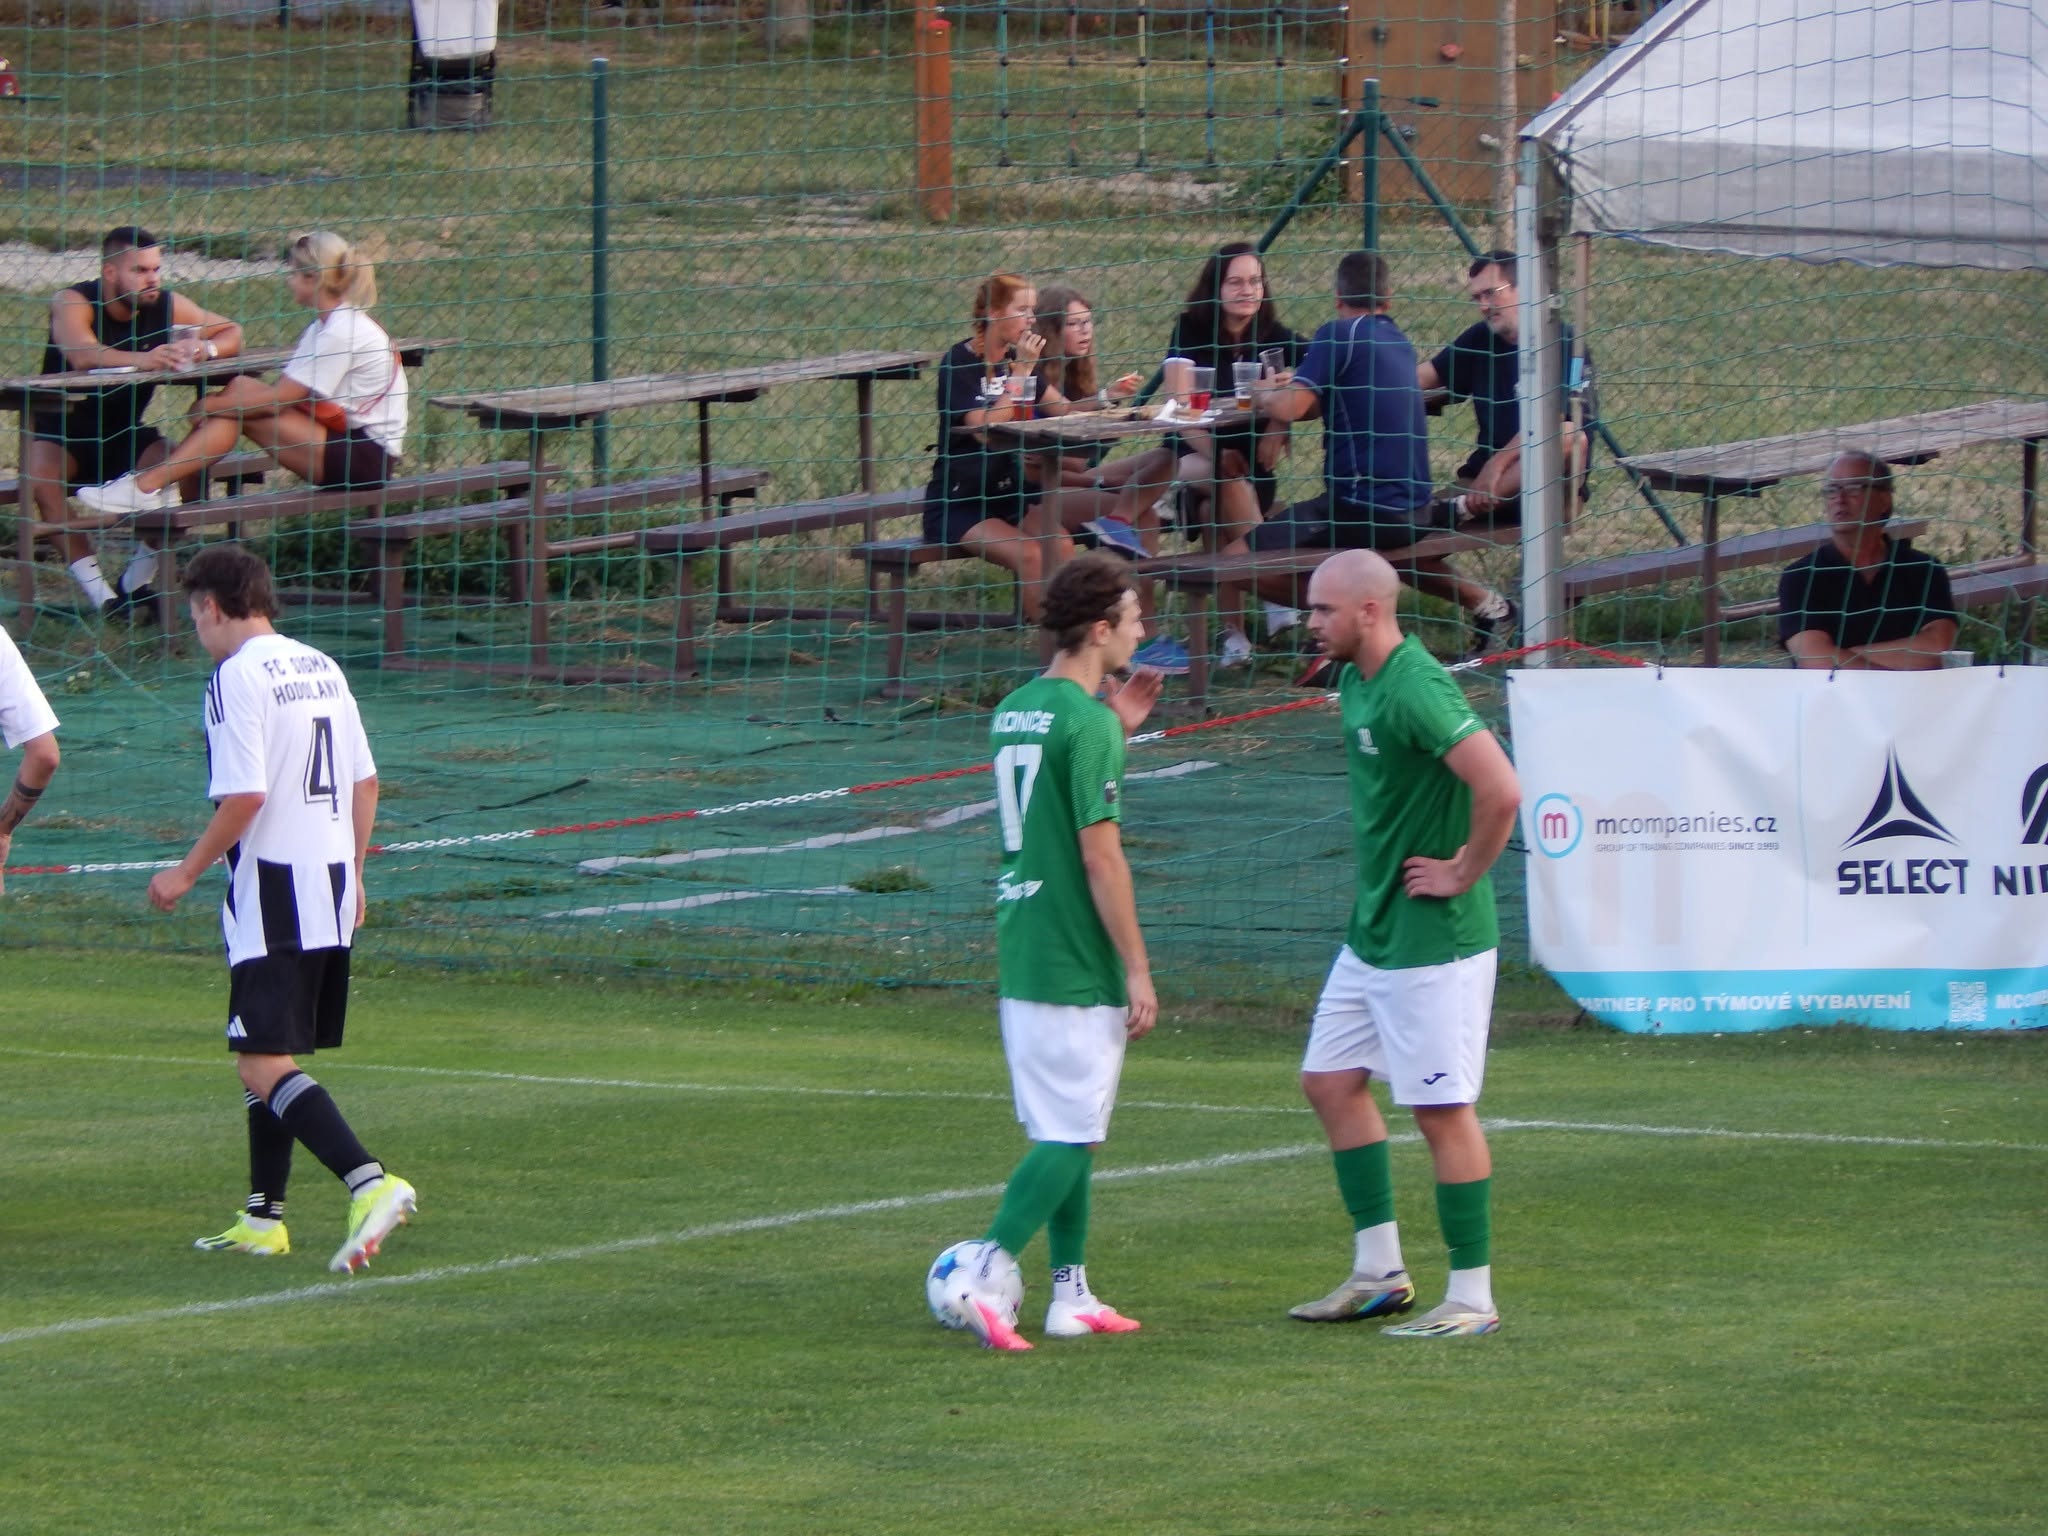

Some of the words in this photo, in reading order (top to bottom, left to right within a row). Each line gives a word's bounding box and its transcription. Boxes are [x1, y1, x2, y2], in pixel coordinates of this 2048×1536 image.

[262, 658, 287, 679] FC
[303, 716, 339, 821] 4
[994, 744, 1043, 852] 17
[1596, 811, 1778, 838] mcompanies.cz
[1838, 859, 1970, 895] SELECT
[1656, 996, 1696, 1012] PRO
[1702, 991, 1792, 1011] TÝMOVÉ
[1799, 991, 1912, 1010] VYBAVENÍ
